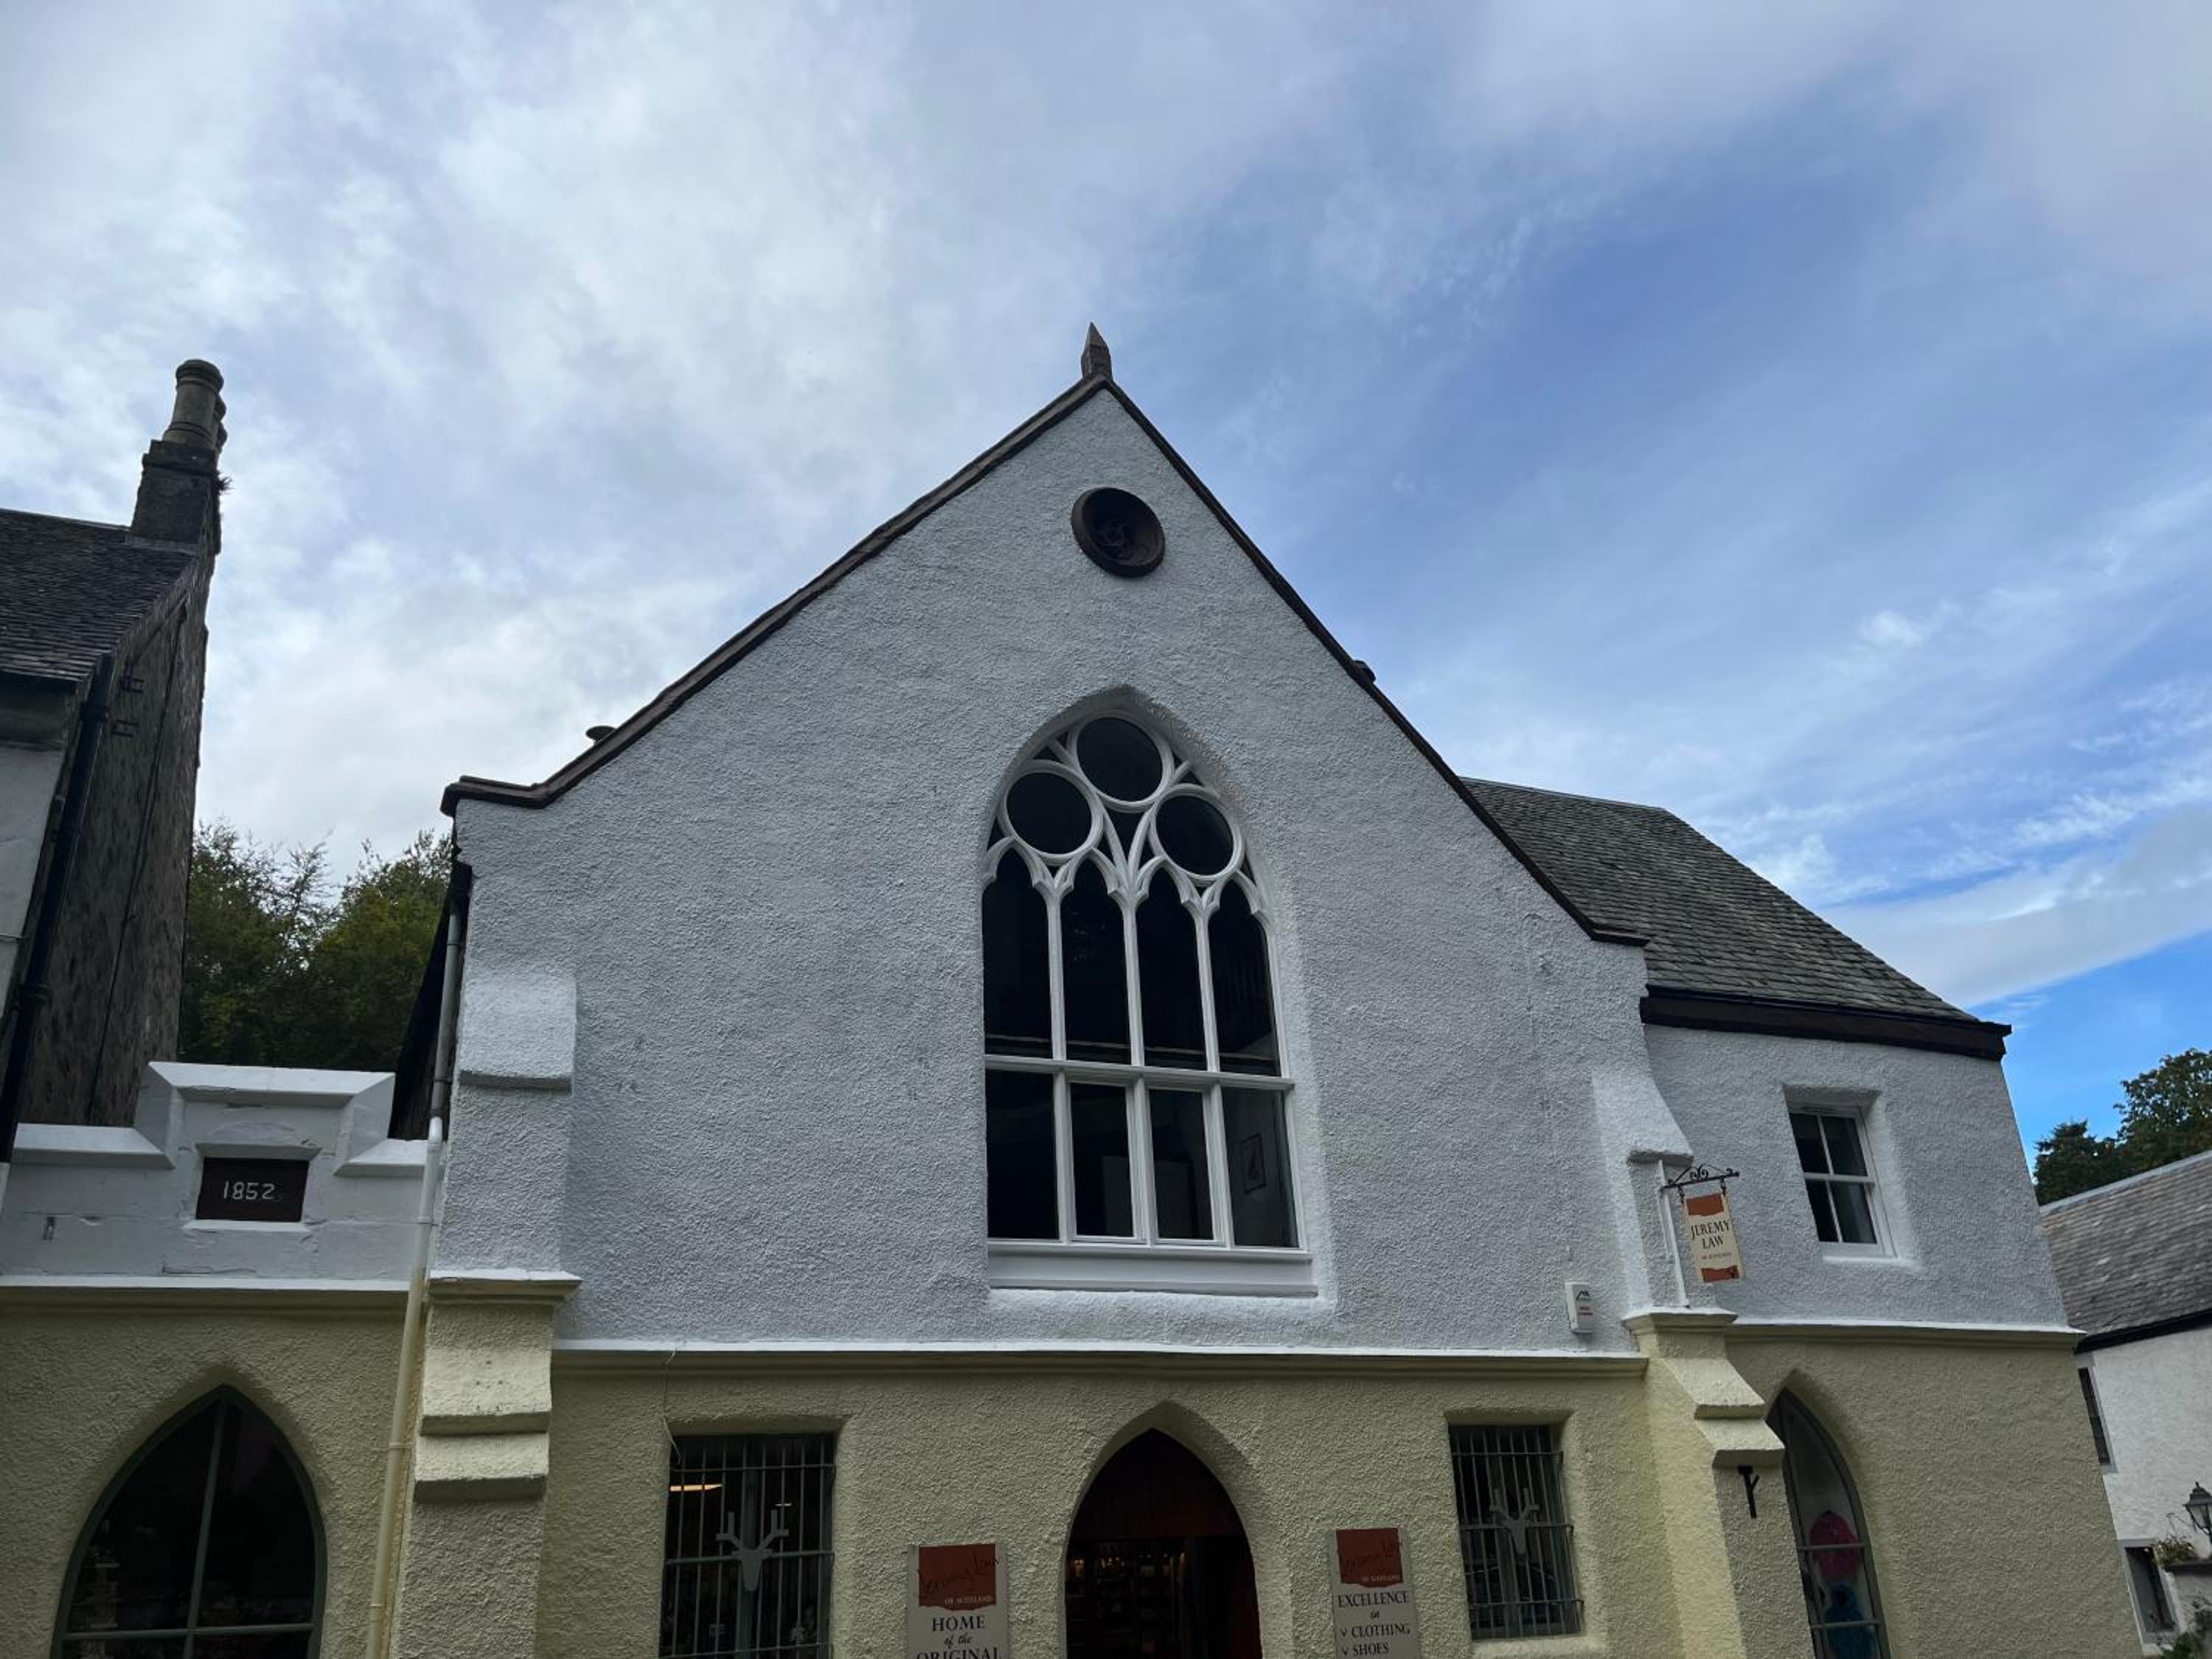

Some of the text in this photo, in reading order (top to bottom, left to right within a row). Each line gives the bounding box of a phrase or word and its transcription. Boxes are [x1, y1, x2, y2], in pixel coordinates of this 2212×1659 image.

[223, 1180, 275, 1200] 1852
[1691, 1219, 1731, 1240] JEREMY
[1701, 1235, 1724, 1249] LAW
[1338, 1591, 1409, 1607] EXCELLENCE
[932, 1615, 986, 1631] HOME
[1352, 1623, 1411, 1638] CLOTHING
[944, 1632, 973, 1649] of the
[1352, 1642, 1390, 1656] SHOES
